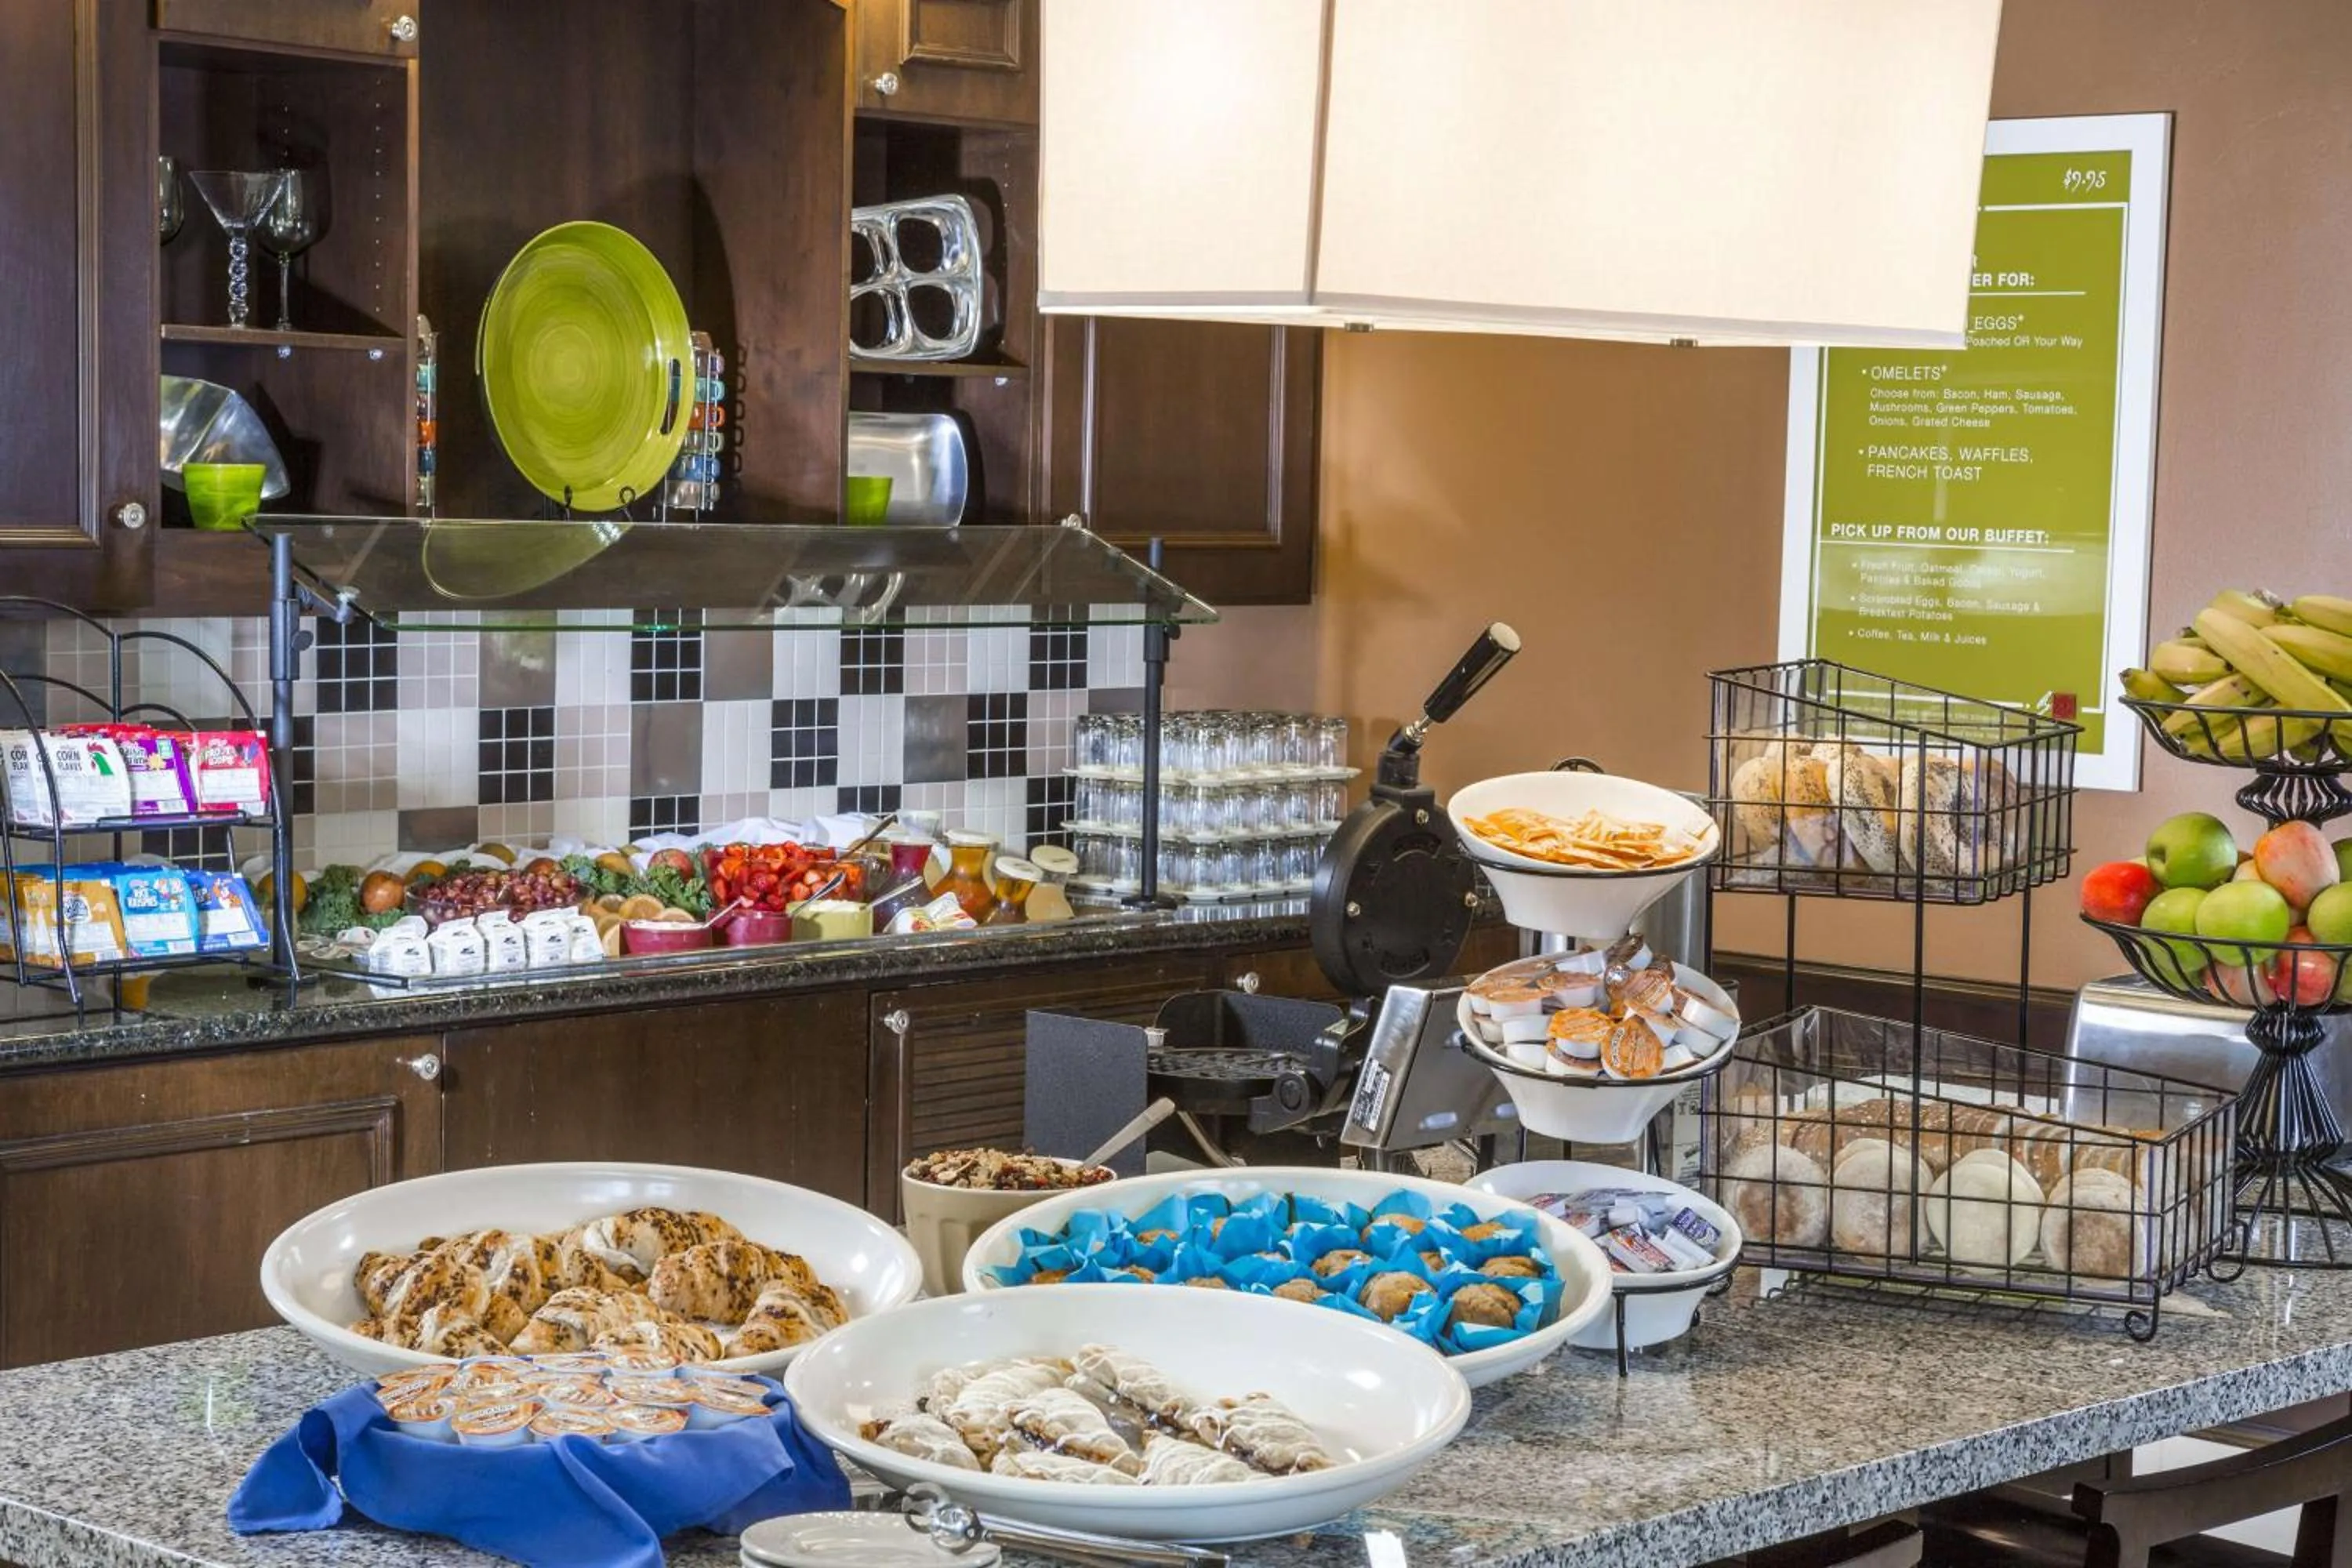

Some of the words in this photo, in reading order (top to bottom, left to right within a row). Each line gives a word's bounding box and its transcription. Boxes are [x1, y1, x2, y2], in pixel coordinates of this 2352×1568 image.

[2063, 169, 2107, 192] $9.95
[1998, 273, 2035, 287] FOR:
[1966, 335, 2011, 347] Poached
[2014, 335, 2030, 347] OR
[2034, 335, 2057, 347] Your
[2060, 334, 2084, 349] Way
[1870, 387, 1909, 399] Choose
[1944, 388, 1981, 401] Bacon,
[2016, 388, 2065, 403] Sausage,
[1869, 401, 1933, 412] Mushrooms,
[1936, 402, 1968, 413] Green
[1912, 416, 1948, 427] Grated
[1951, 416, 1991, 428] Cheese
[1868, 446, 1953, 463] PANCAKES,
[1959, 447, 2034, 464] WAFFLES,
[1867, 463, 1928, 480] FRENCH
[1933, 466, 1983, 481] TOAST
[1831, 523, 1866, 538] PICK
[1871, 524, 1892, 539] UP
[1896, 526, 1940, 540] FROM
[1946, 528, 1980, 542] OUR
[1984, 528, 2050, 544] BUFFET:
[1857, 628, 1893, 640] Coffee,
[1896, 629, 1917, 641] Tea,
[1921, 631, 1940, 642] Milk
[1944, 633, 1951, 644] &
[1955, 633, 1987, 646] Juices
